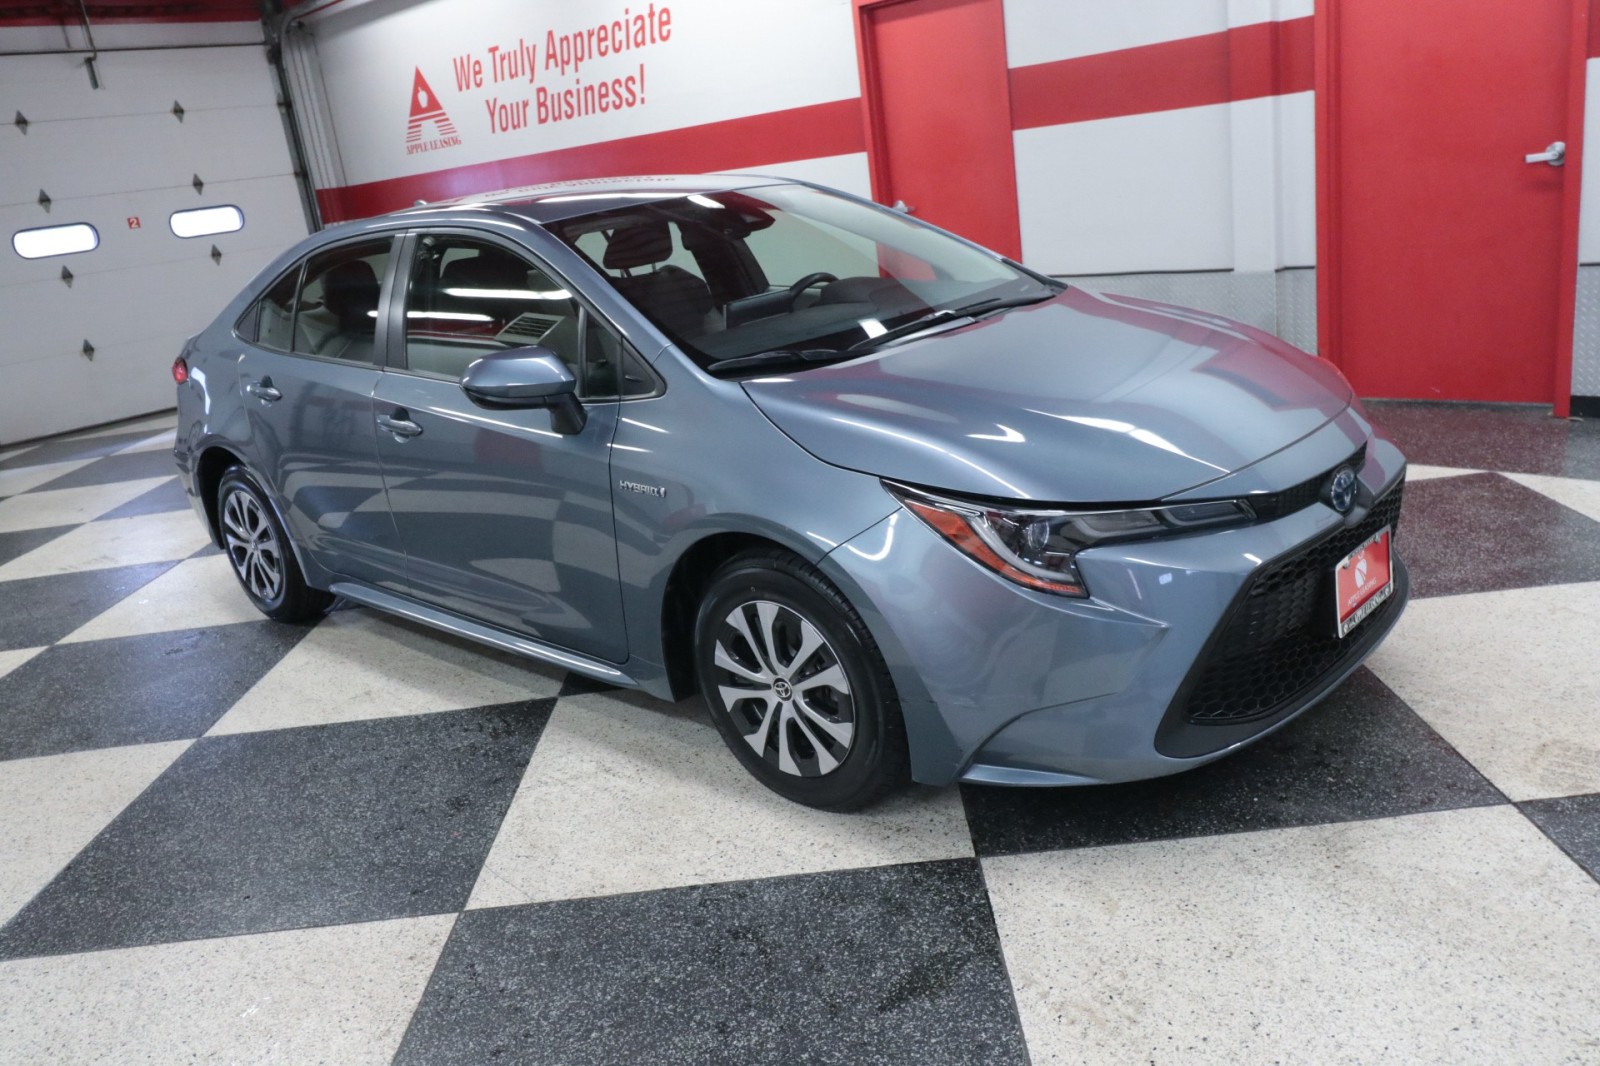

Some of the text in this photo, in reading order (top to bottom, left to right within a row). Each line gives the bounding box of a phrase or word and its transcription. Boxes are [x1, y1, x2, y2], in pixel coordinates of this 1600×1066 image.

[453, 3, 672, 92] We Truly Appreciate
[485, 63, 646, 134] Your Business!
[406, 136, 462, 155] APPLE LEASING
[129, 218, 139, 228] 2
[619, 480, 659, 496] HYBRID
